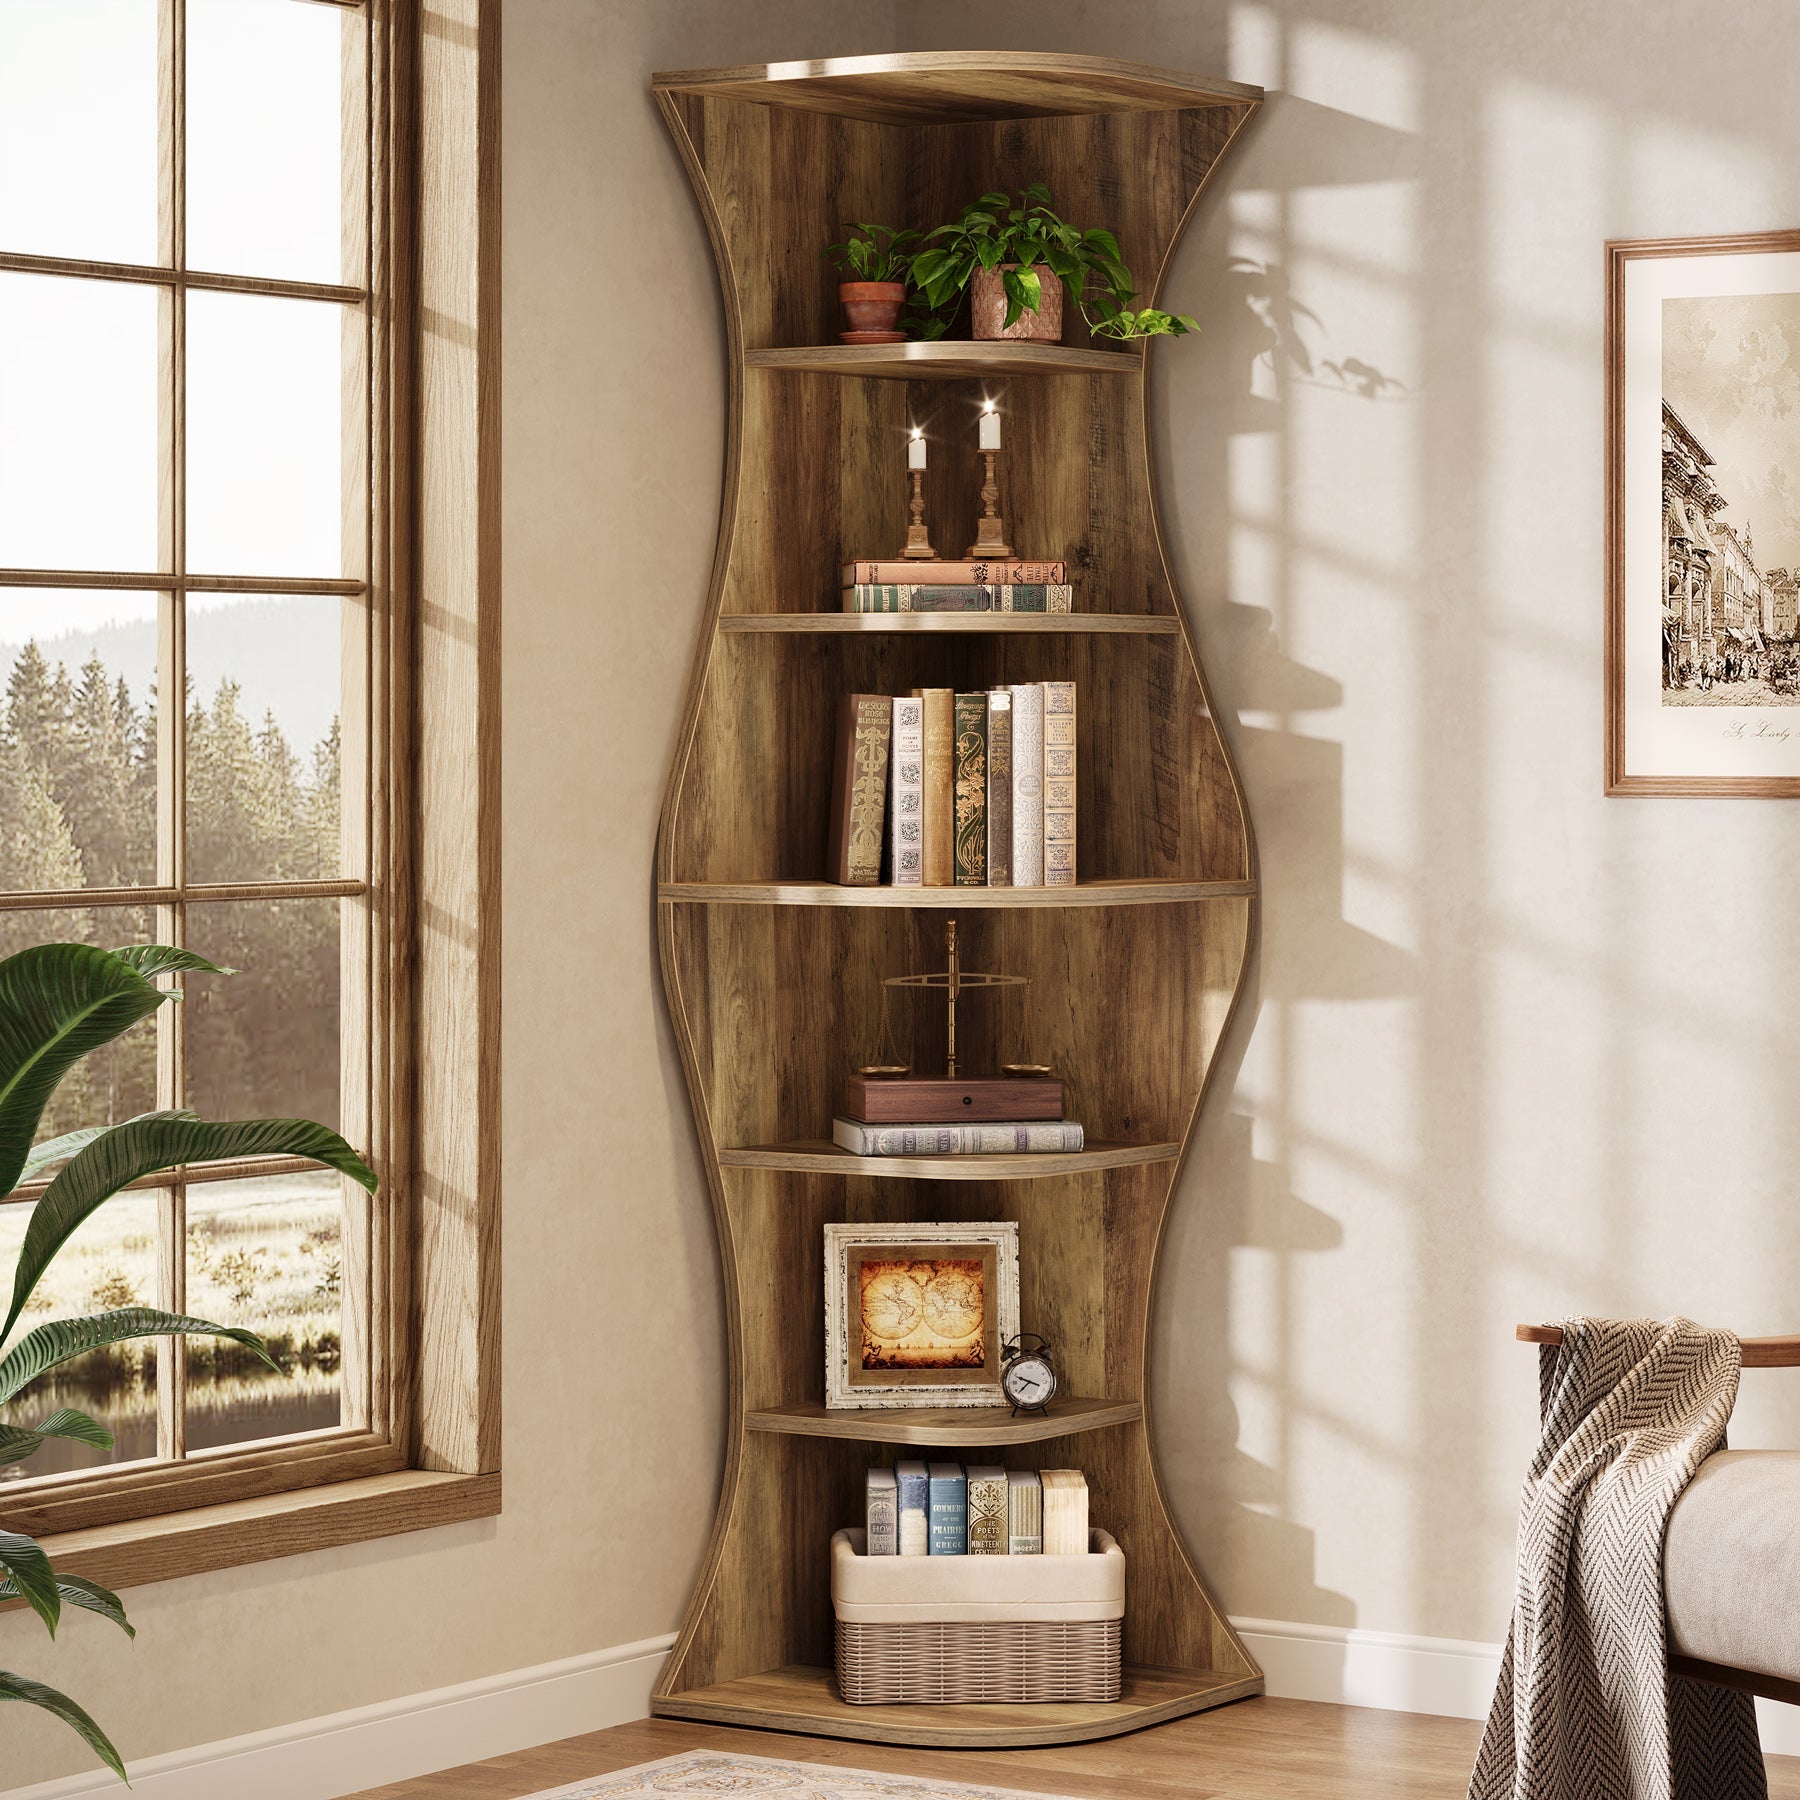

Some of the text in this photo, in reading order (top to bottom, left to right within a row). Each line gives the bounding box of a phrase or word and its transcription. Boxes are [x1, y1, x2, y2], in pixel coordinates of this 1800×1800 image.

[1026, 566, 1034, 582] LIVE
[905, 1132, 914, 1153] HOW
[940, 1131, 949, 1152] WHY
[871, 1525, 894, 1533] HOW
